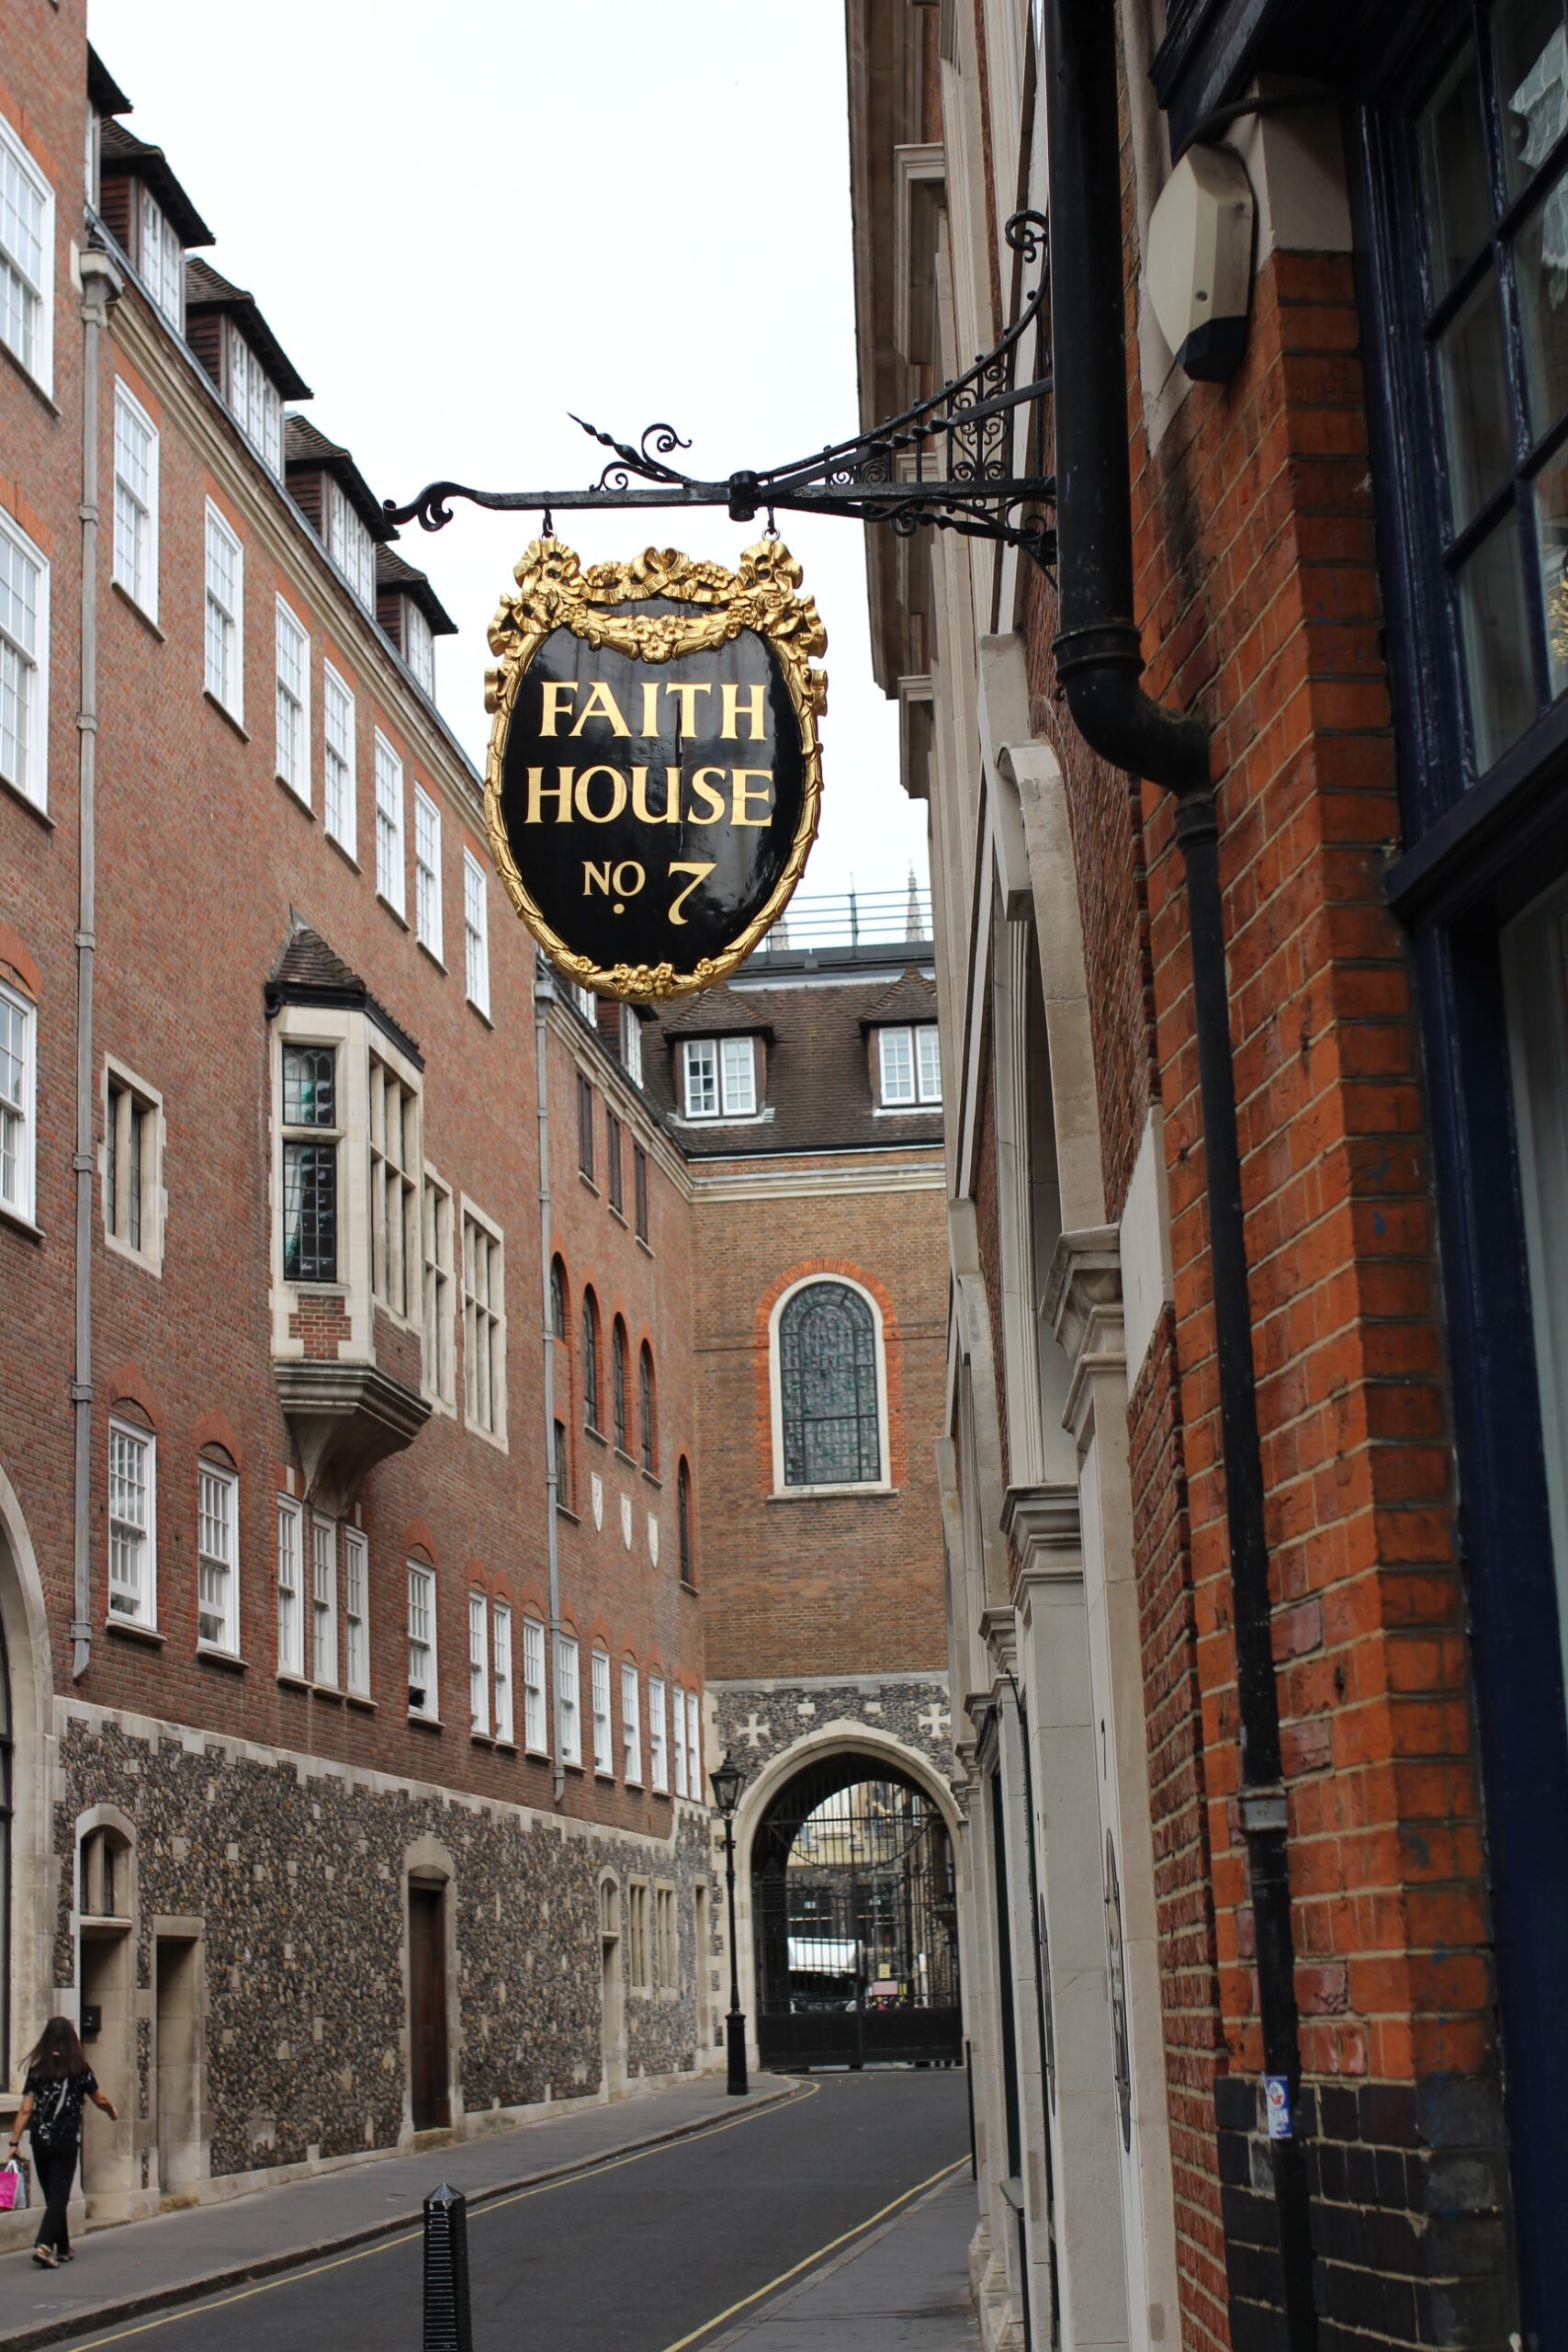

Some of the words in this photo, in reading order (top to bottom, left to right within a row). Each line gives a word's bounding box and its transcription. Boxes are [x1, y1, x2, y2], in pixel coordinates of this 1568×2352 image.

[538, 681, 768, 741] FAITH
[524, 765, 774, 827] HOUSE
[667, 861, 717, 925] 7
